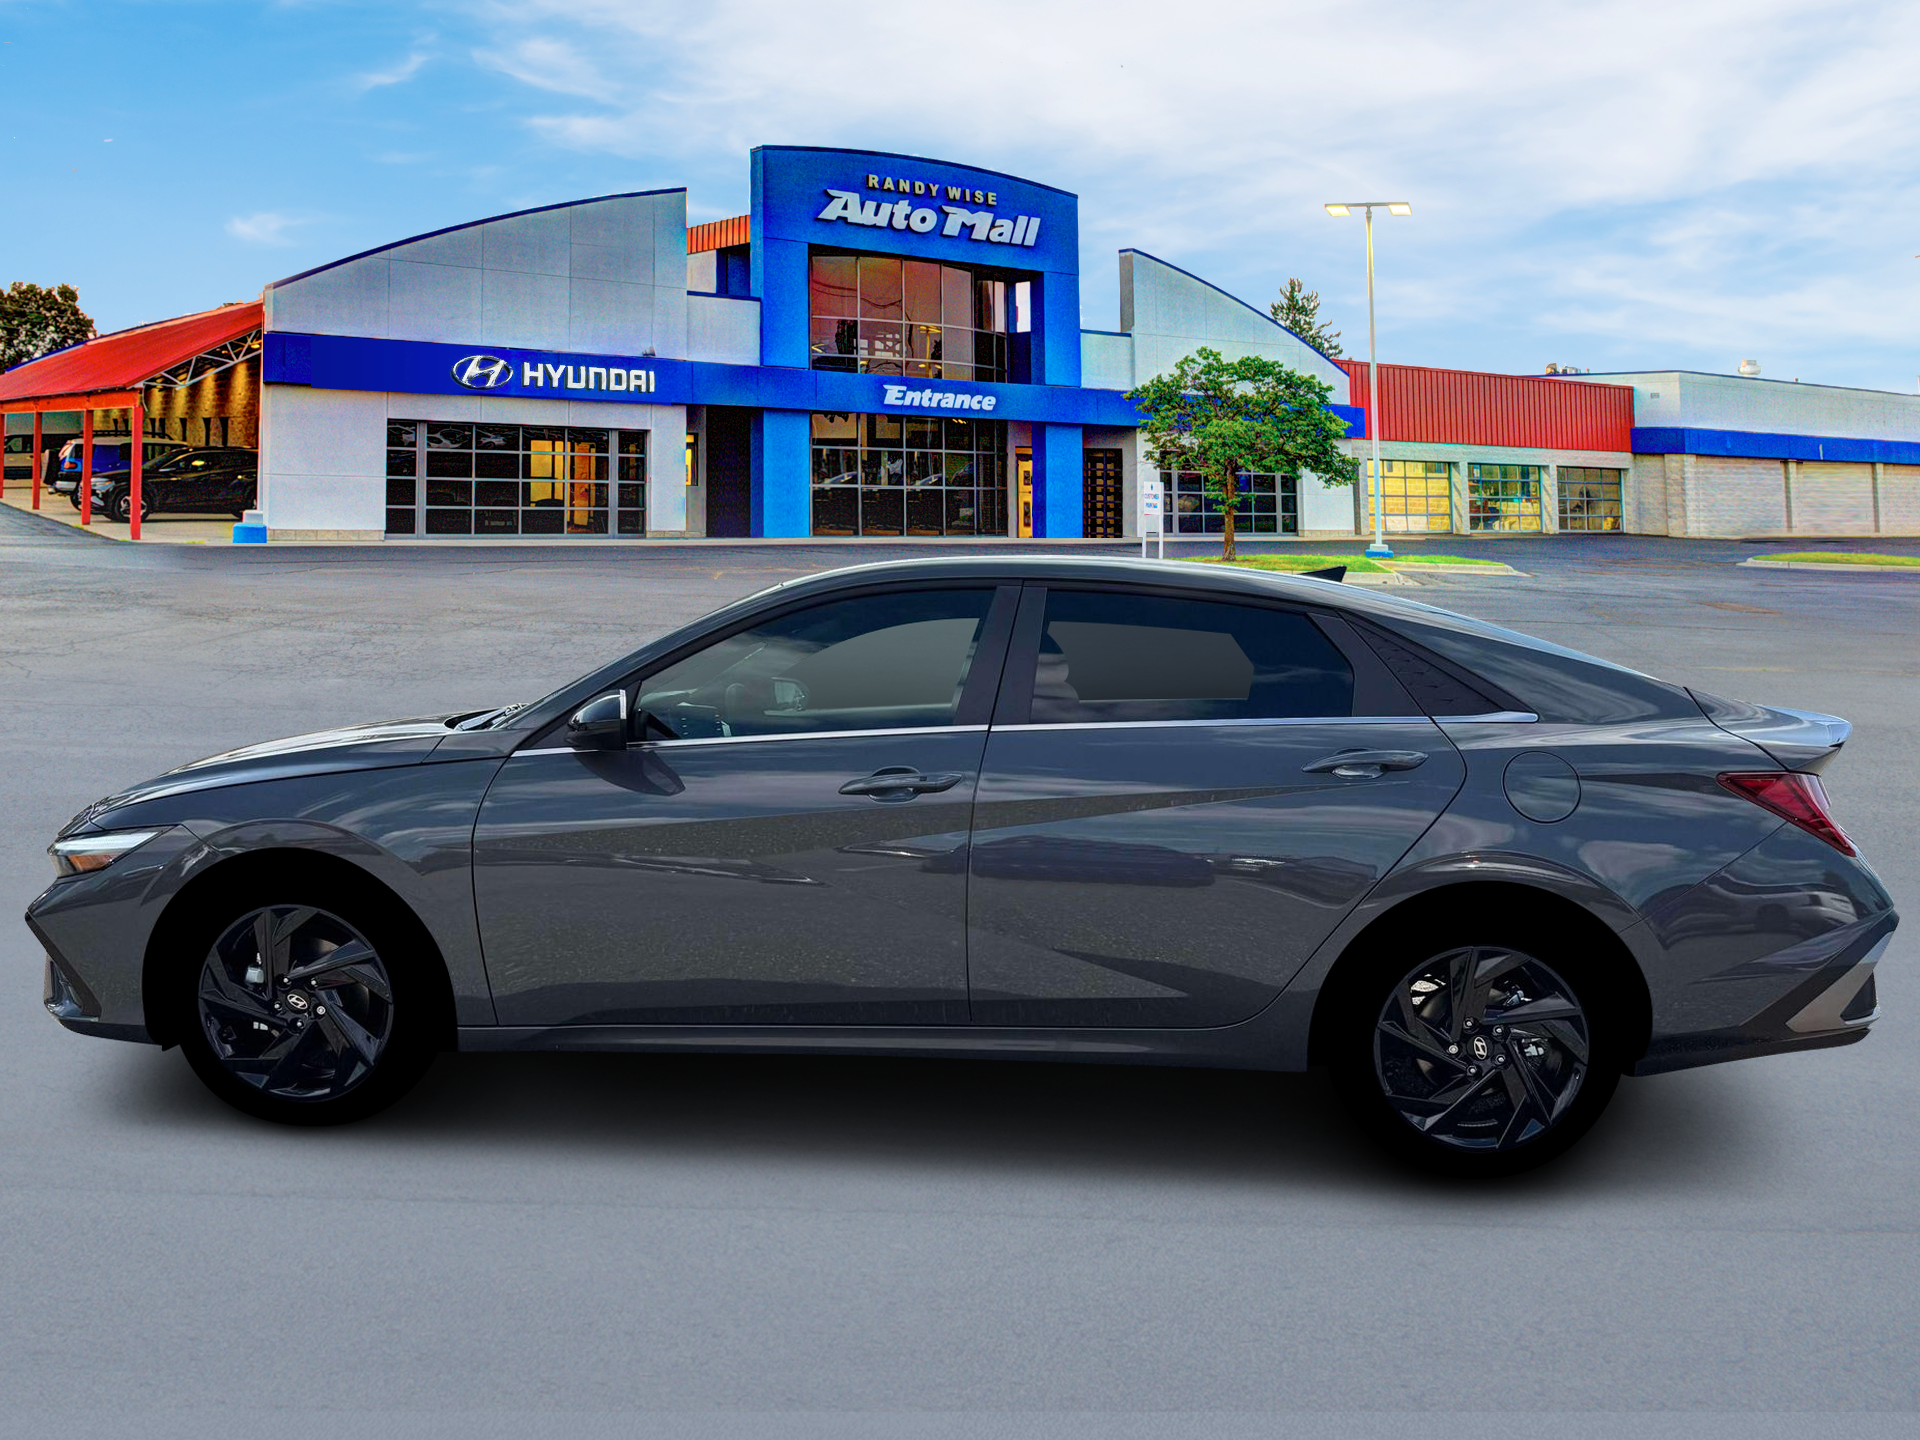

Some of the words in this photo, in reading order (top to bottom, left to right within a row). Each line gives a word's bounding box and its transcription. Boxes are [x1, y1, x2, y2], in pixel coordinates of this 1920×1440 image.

[866, 173, 939, 197] RANDY
[946, 186, 997, 206] WISE
[816, 188, 938, 234] Auto
[940, 205, 1041, 247] Mall
[521, 362, 656, 393] HYUNDAI
[883, 384, 996, 411] Entrance
